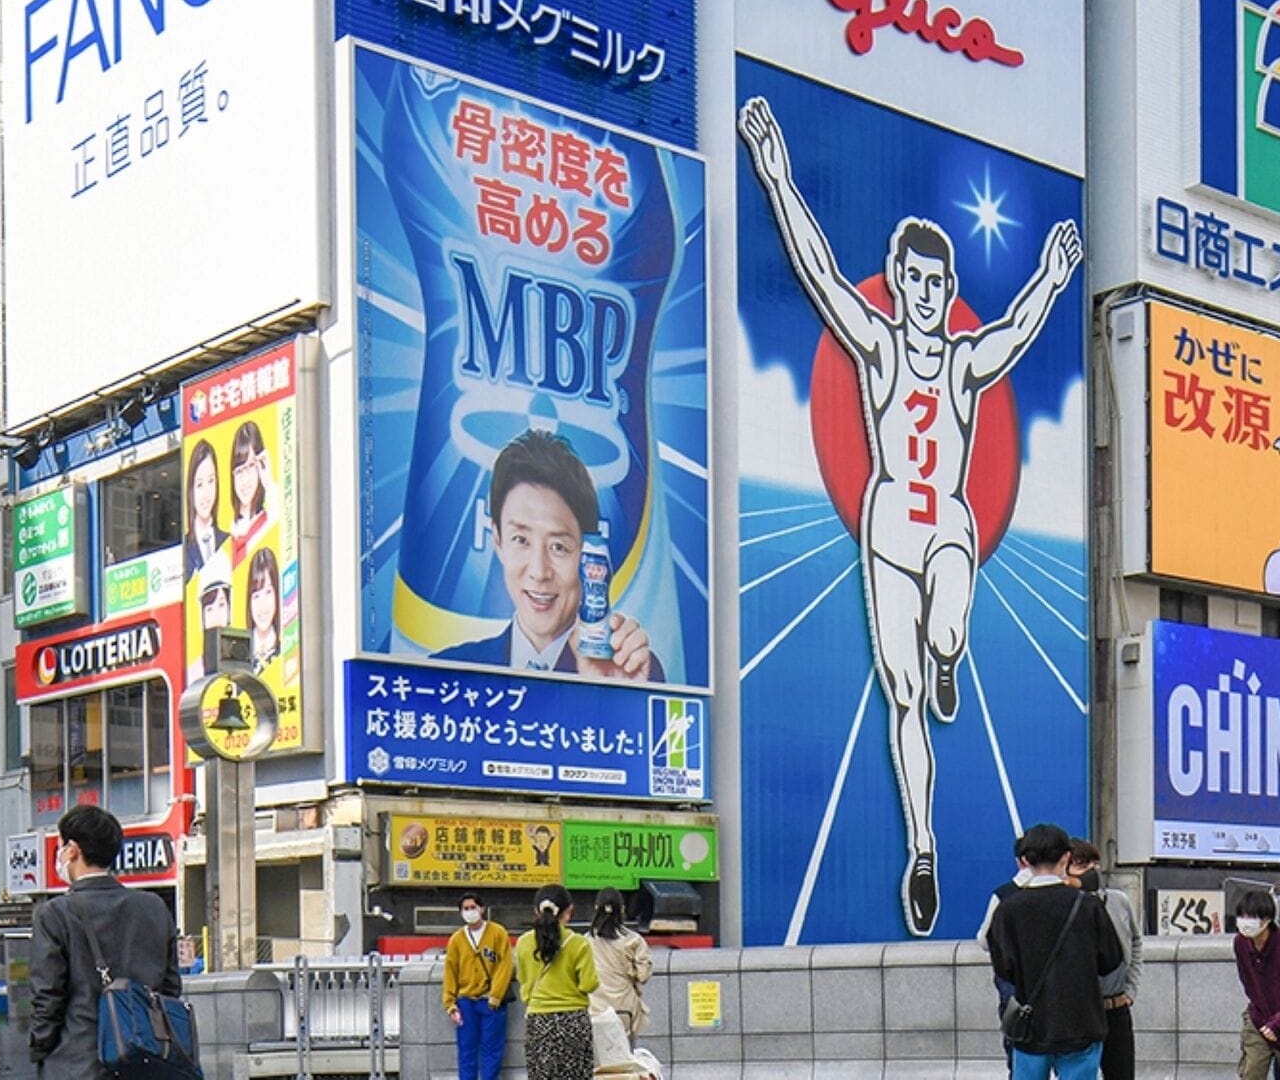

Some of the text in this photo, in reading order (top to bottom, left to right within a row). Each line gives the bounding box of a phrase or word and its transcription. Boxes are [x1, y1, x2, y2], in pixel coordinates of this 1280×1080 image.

[70, 59, 229, 199] 正直品質。
[452, 99, 630, 208] 骨密度を
[473, 176, 610, 266] 高める
[453, 255, 629, 404] MBP
[1173, 326, 1263, 385] かぜに
[208, 356, 291, 417] 住宅情報館
[1162, 368, 1272, 452] 改源
[903, 386, 941, 527] グリコ
[58, 625, 154, 675] LOTTERIA
[367, 674, 528, 712] スキージャンプ
[365, 707, 644, 756] 応援ありがとうございました!
[392, 754, 468, 774] 雪印メグミルク
